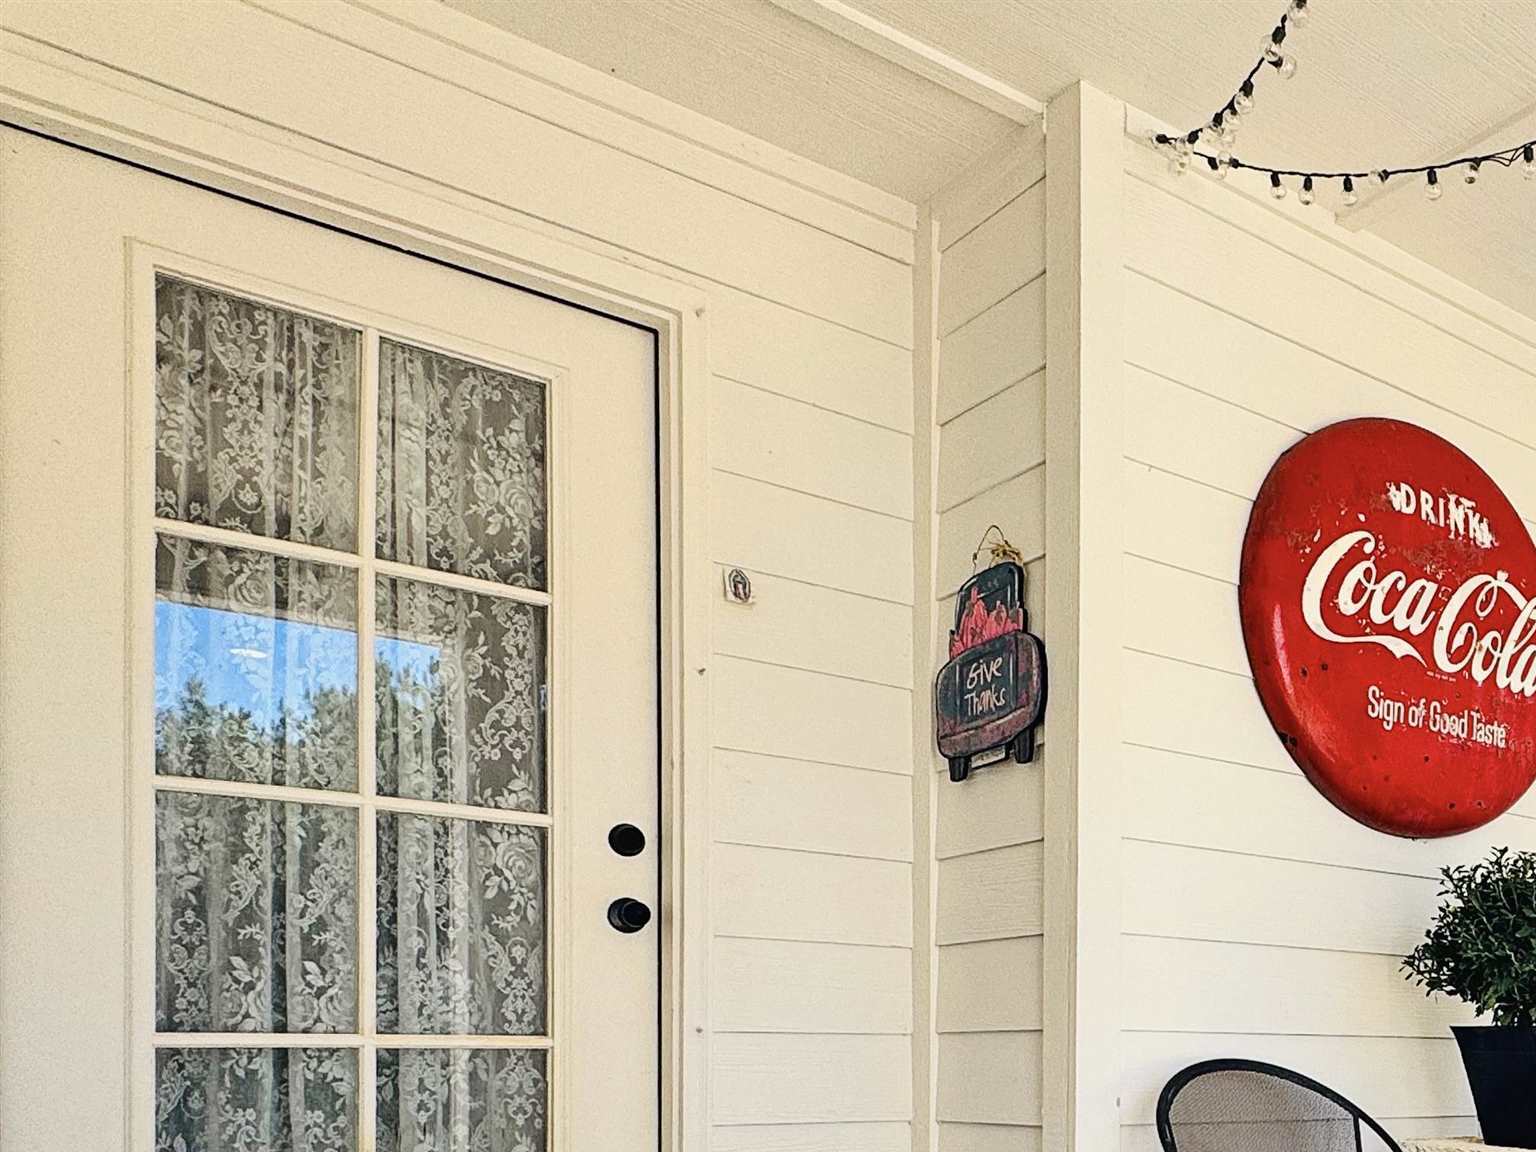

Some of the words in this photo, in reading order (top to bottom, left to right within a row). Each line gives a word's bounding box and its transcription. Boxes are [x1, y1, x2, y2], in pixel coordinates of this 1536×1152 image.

[1394, 482, 1493, 548] DRINK
[967, 657, 1002, 689] Give
[964, 684, 1006, 716] Thanks
[1367, 685, 1405, 731] Sign
[1408, 698, 1427, 728] of
[1429, 701, 1468, 739] Good
[1470, 710, 1506, 748] Taste
